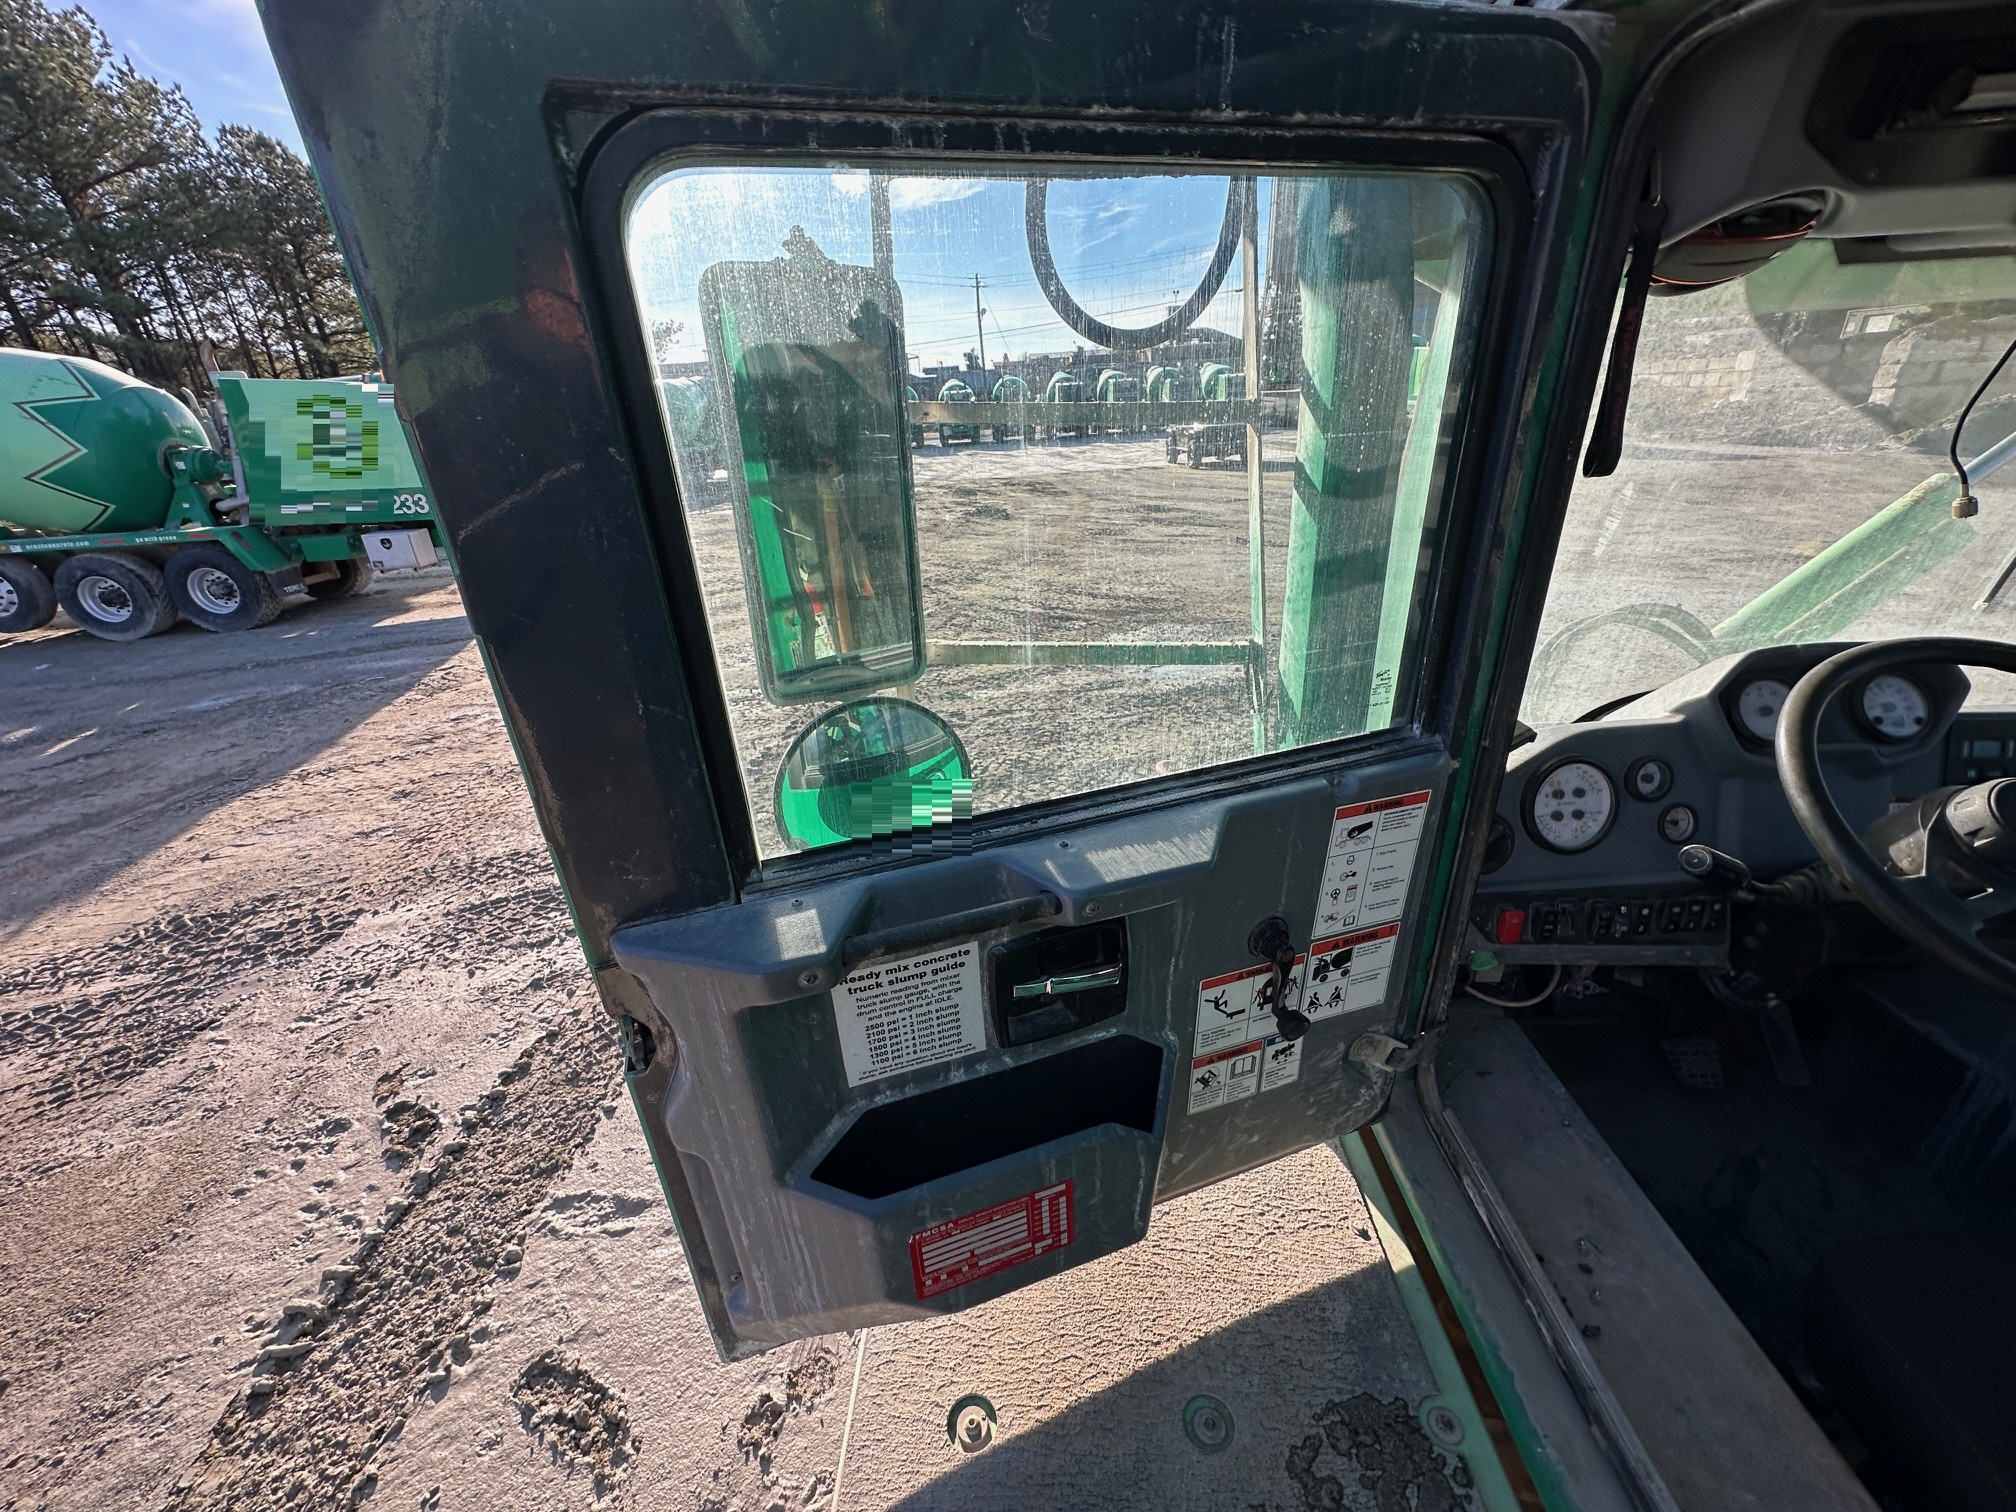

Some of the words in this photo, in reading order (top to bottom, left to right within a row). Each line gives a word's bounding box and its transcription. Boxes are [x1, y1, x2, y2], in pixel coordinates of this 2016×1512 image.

[1343, 931, 1379, 946] WARNING
[885, 964, 910, 976] mix
[914, 948, 970, 968] concrete
[847, 981, 884, 995] truck
[887, 971, 927, 986] slump
[930, 960, 966, 976] guide
[856, 991, 889, 1003] Numeric
[890, 982, 919, 995] reading
[921, 978, 938, 987] from
[940, 973, 960, 982] mixer
[856, 1008, 877, 1017] drum
[878, 1001, 906, 1012] control
[916, 993, 936, 1002] FULL
[938, 986, 963, 996] charge
[857, 1001, 877, 1010] truck
[879, 995, 902, 1005] slump
[904, 989, 930, 999] gauge,
[931, 983, 948, 991] with
[898, 1003, 924, 1014] engine
[934, 995, 954, 1004] IDLE.
[865, 1022, 885, 1032] 2500
[887, 1018, 899, 1027] psi
[915, 1010, 933, 1019] inch
[934, 1003, 959, 1013] slump
[866, 1029, 886, 1039] 2100
[888, 1024, 901, 1034] psi
[916, 1017, 934, 1026] inch
[936, 1010, 960, 1020] slump
[868, 1035, 887, 1045] 1700
[889, 1032, 901, 1042] psi
[917, 1024, 934, 1033] inch
[936, 1017, 960, 1028] slump
[869, 1043, 888, 1052] 1500
[890, 1039, 902, 1048] psi
[918, 1030, 935, 1040] inch
[937, 1024, 961, 1034] slump
[870, 1050, 888, 1059] 1300
[891, 1046, 903, 1055] psi
[919, 1038, 936, 1046] inch
[938, 1031, 962, 1041] slump
[871, 1056, 890, 1066] 1100
[892, 1053, 904, 1062] psi
[919, 1044, 937, 1053] inch
[938, 1038, 962, 1048] slump
[1217, 1047, 1247, 1062] WARNING
[915, 1222, 955, 1240] FMCSA
